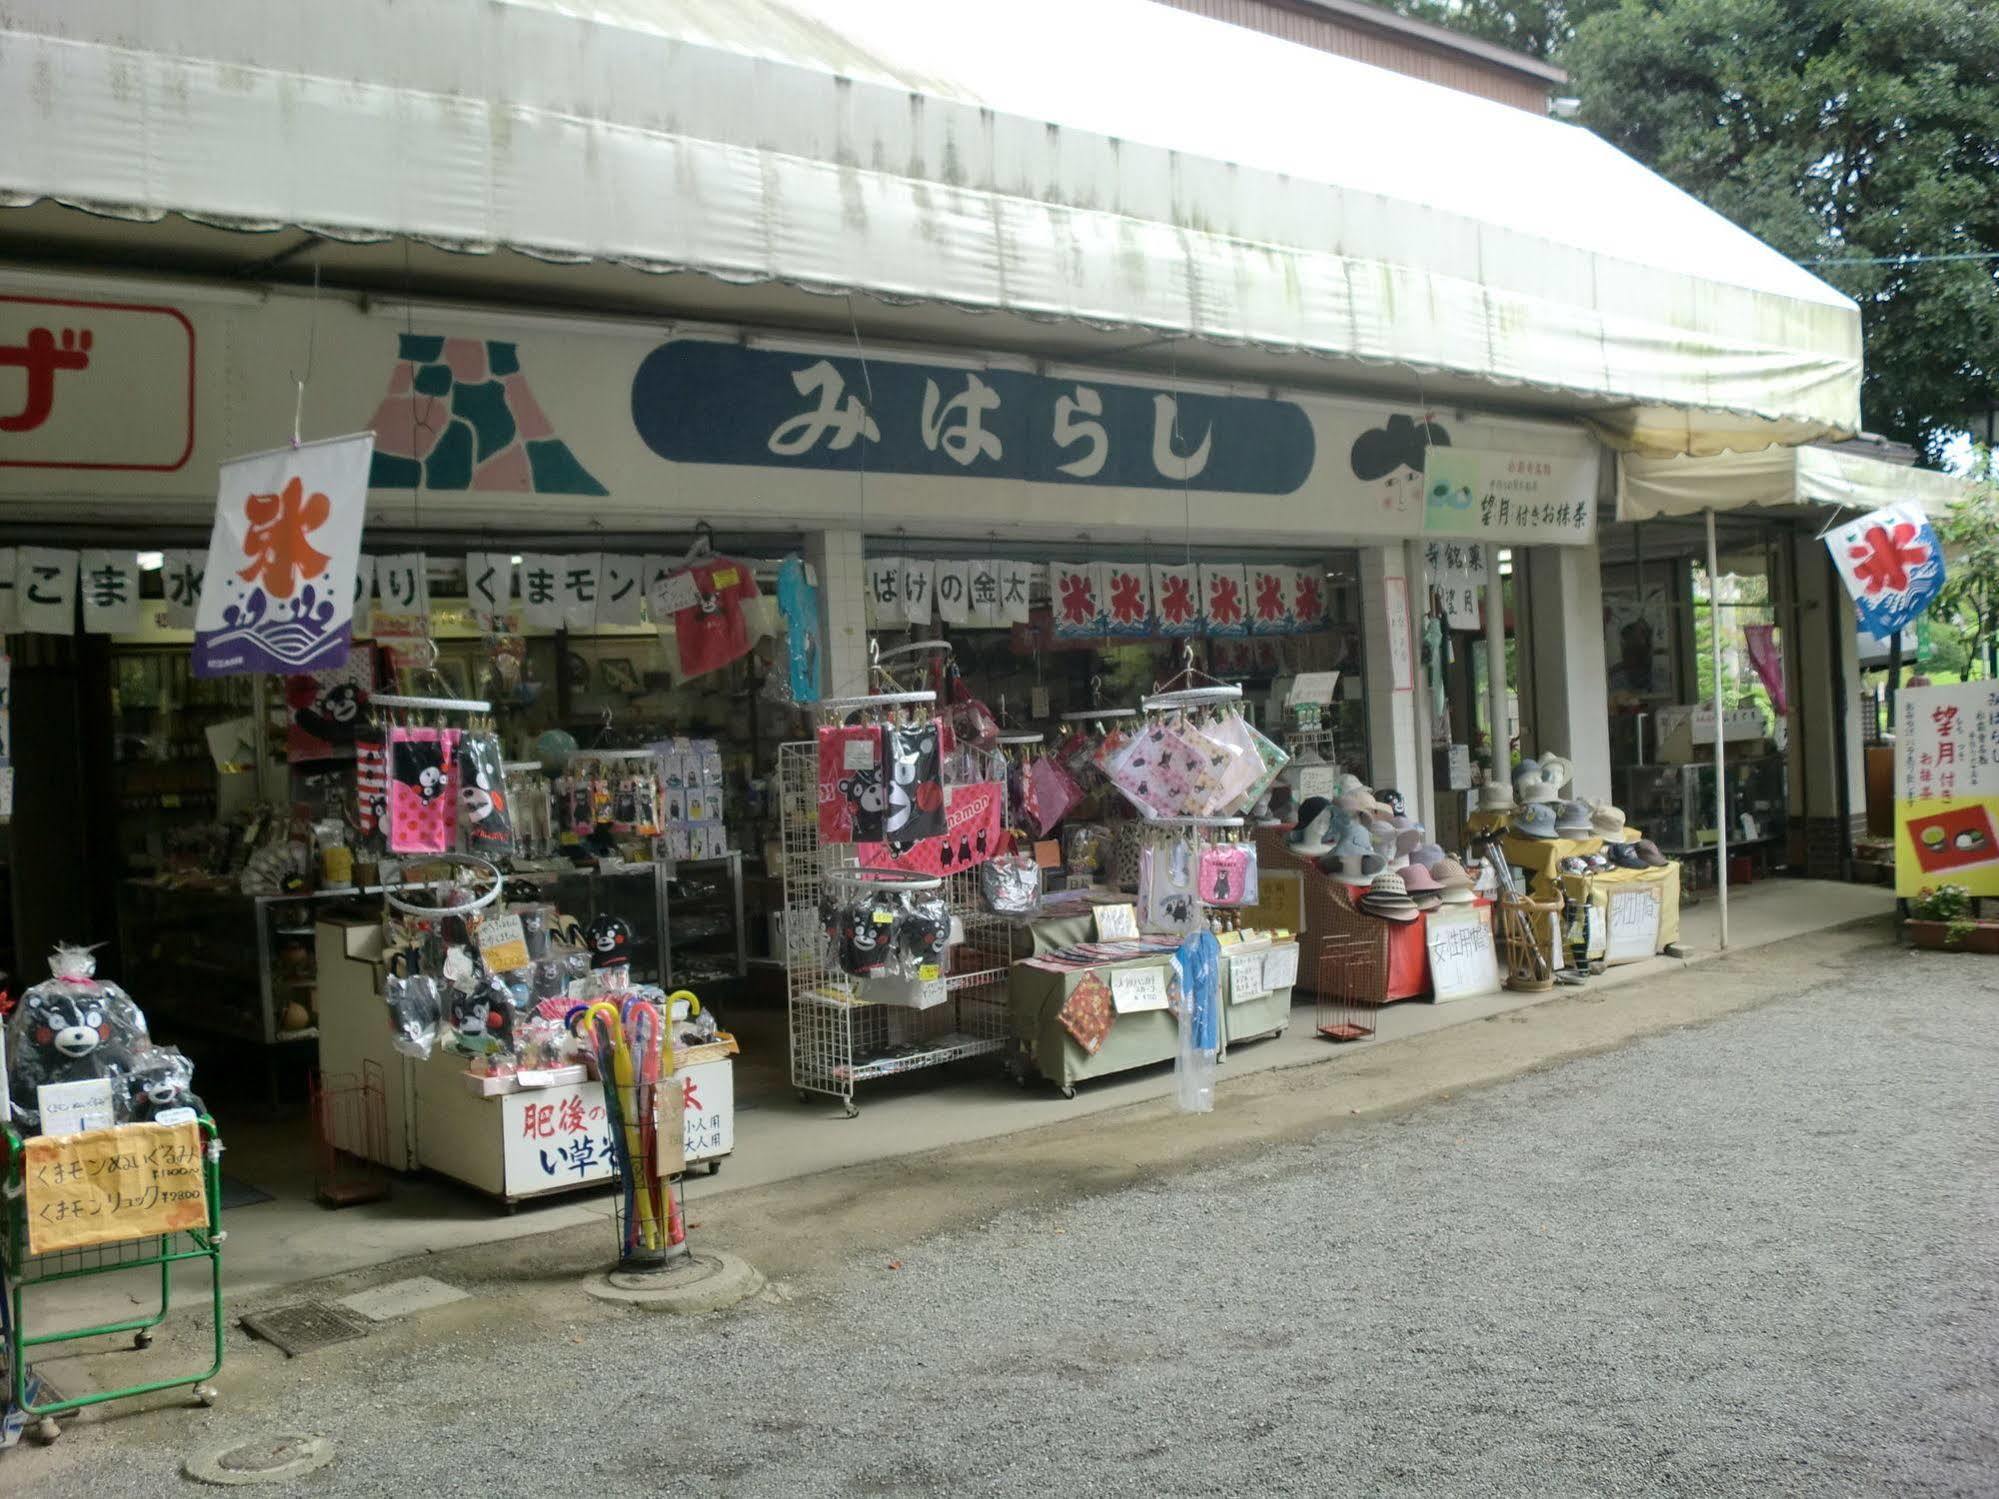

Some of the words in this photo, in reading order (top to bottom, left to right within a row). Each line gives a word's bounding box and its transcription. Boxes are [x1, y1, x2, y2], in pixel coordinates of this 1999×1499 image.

[768, 359, 1212, 480] みはらし
[237, 477, 332, 600] 氷
[1848, 522, 1928, 594] 氷
[0, 565, 127, 607] こま
[476, 566, 676, 606] くまモン
[865, 569, 1026, 605] ばけの金太
[684, 1132, 721, 1152] 大人用
[685, 1114, 721, 1132] 小人用
